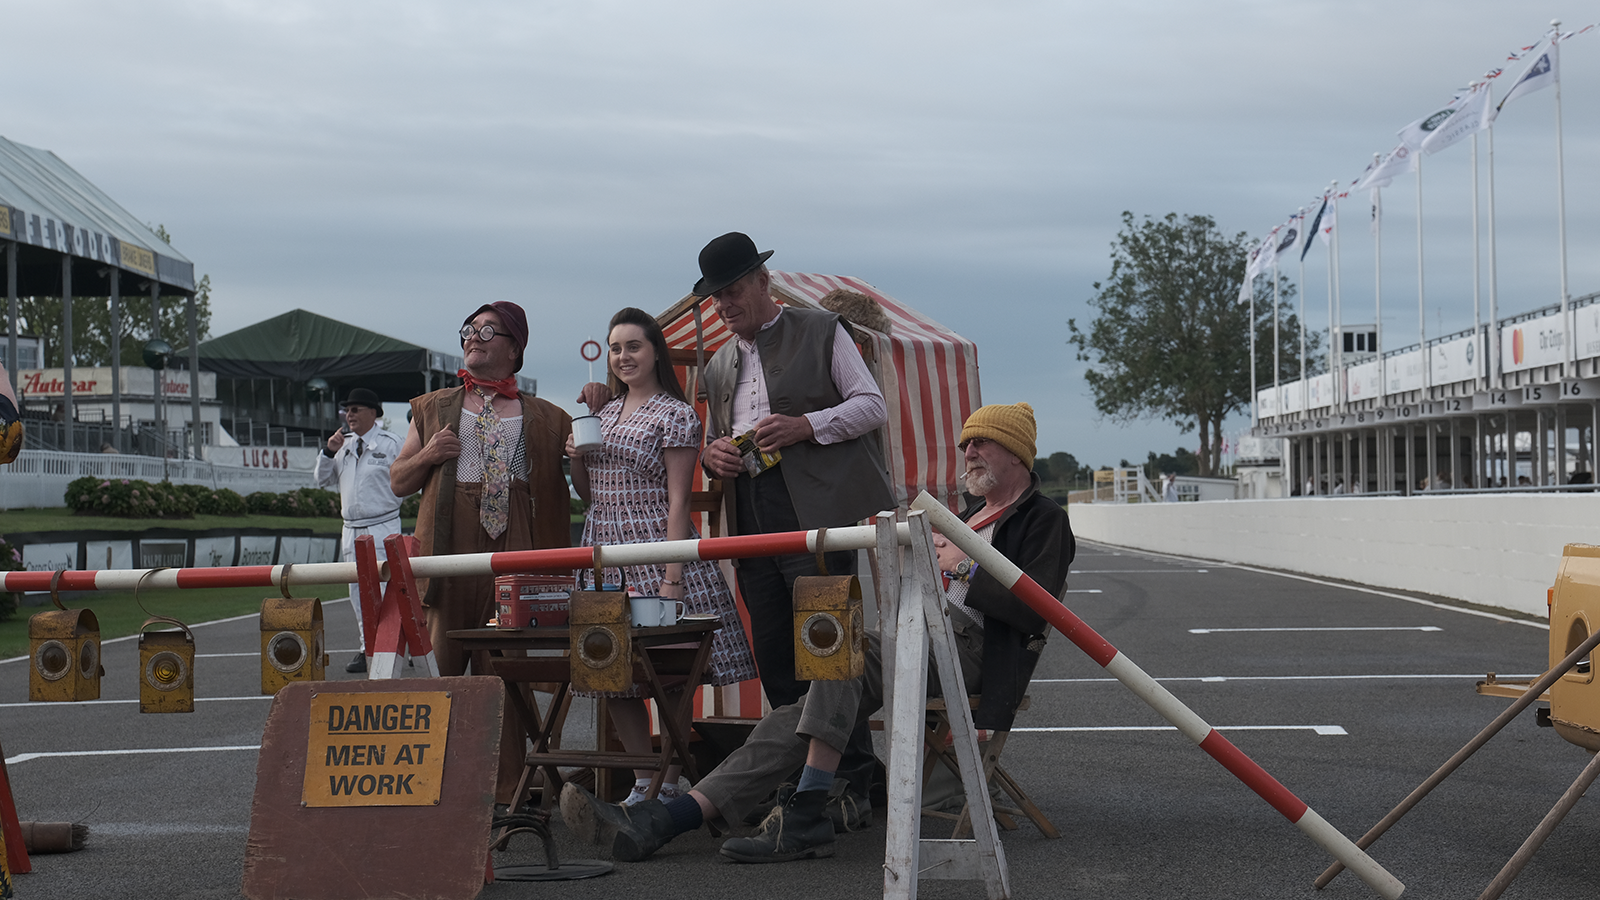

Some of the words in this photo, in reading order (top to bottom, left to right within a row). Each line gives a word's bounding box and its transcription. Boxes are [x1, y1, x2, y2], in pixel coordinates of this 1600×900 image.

[25, 209, 112, 264] FERODO
[1526, 388, 1541, 400] 15
[1563, 382, 1581, 395] 16
[1491, 393, 1506, 404] 14
[1421, 403, 1433, 414] 11
[1447, 400, 1461, 411] 12
[1358, 413, 1364, 422] 8
[1377, 409, 1384, 419] 9
[1397, 407, 1410, 417] 10
[1316, 420, 1322, 428] 6
[1340, 416, 1346, 424] 7
[1263, 427, 1269, 435] 2
[1287, 424, 1293, 432] 4
[1301, 422, 1307, 430] 5
[242, 450, 289, 469] LUCAS
[328, 704, 431, 731] DANGER
[325, 744, 386, 766] MEN
[394, 744, 430, 765] AT
[329, 774, 415, 795] WORK
